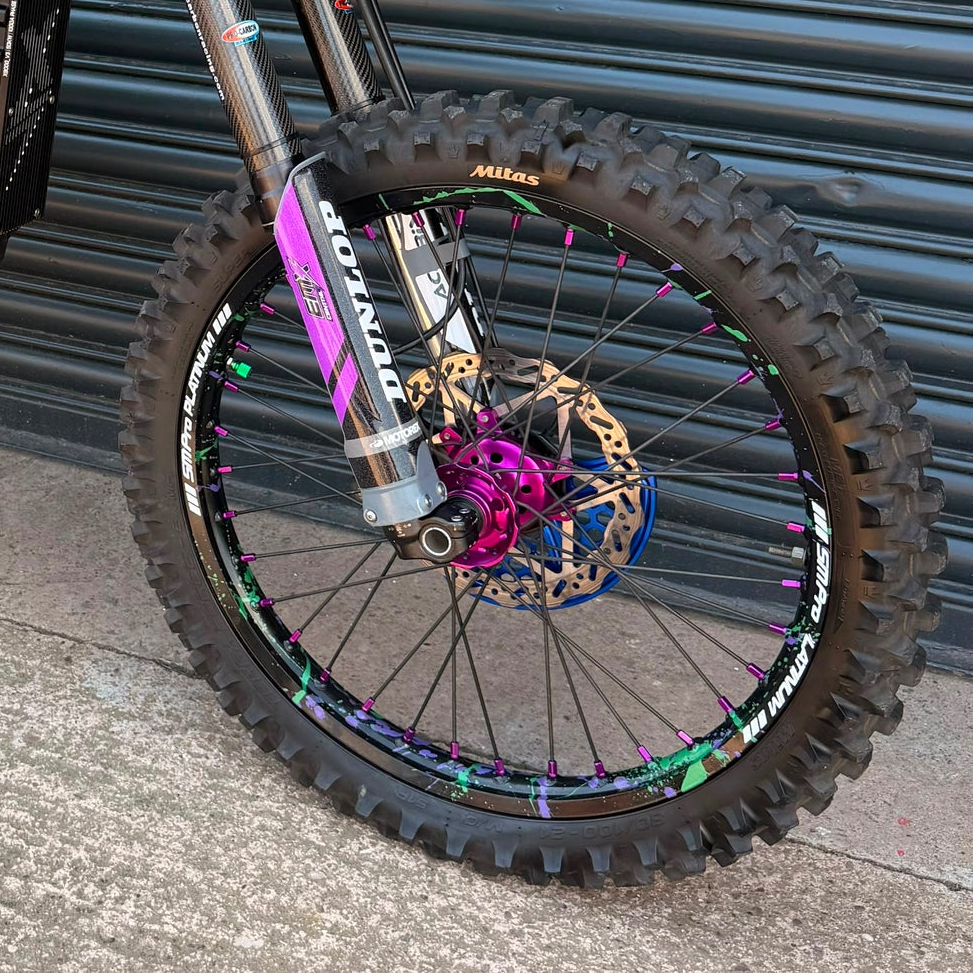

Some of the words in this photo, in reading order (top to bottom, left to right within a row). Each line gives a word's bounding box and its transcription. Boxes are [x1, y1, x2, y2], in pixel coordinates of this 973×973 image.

[469, 165, 540, 186] Mitas
[319, 200, 407, 403] DUNLOP
[183, 330, 215, 418] PLATINUM
